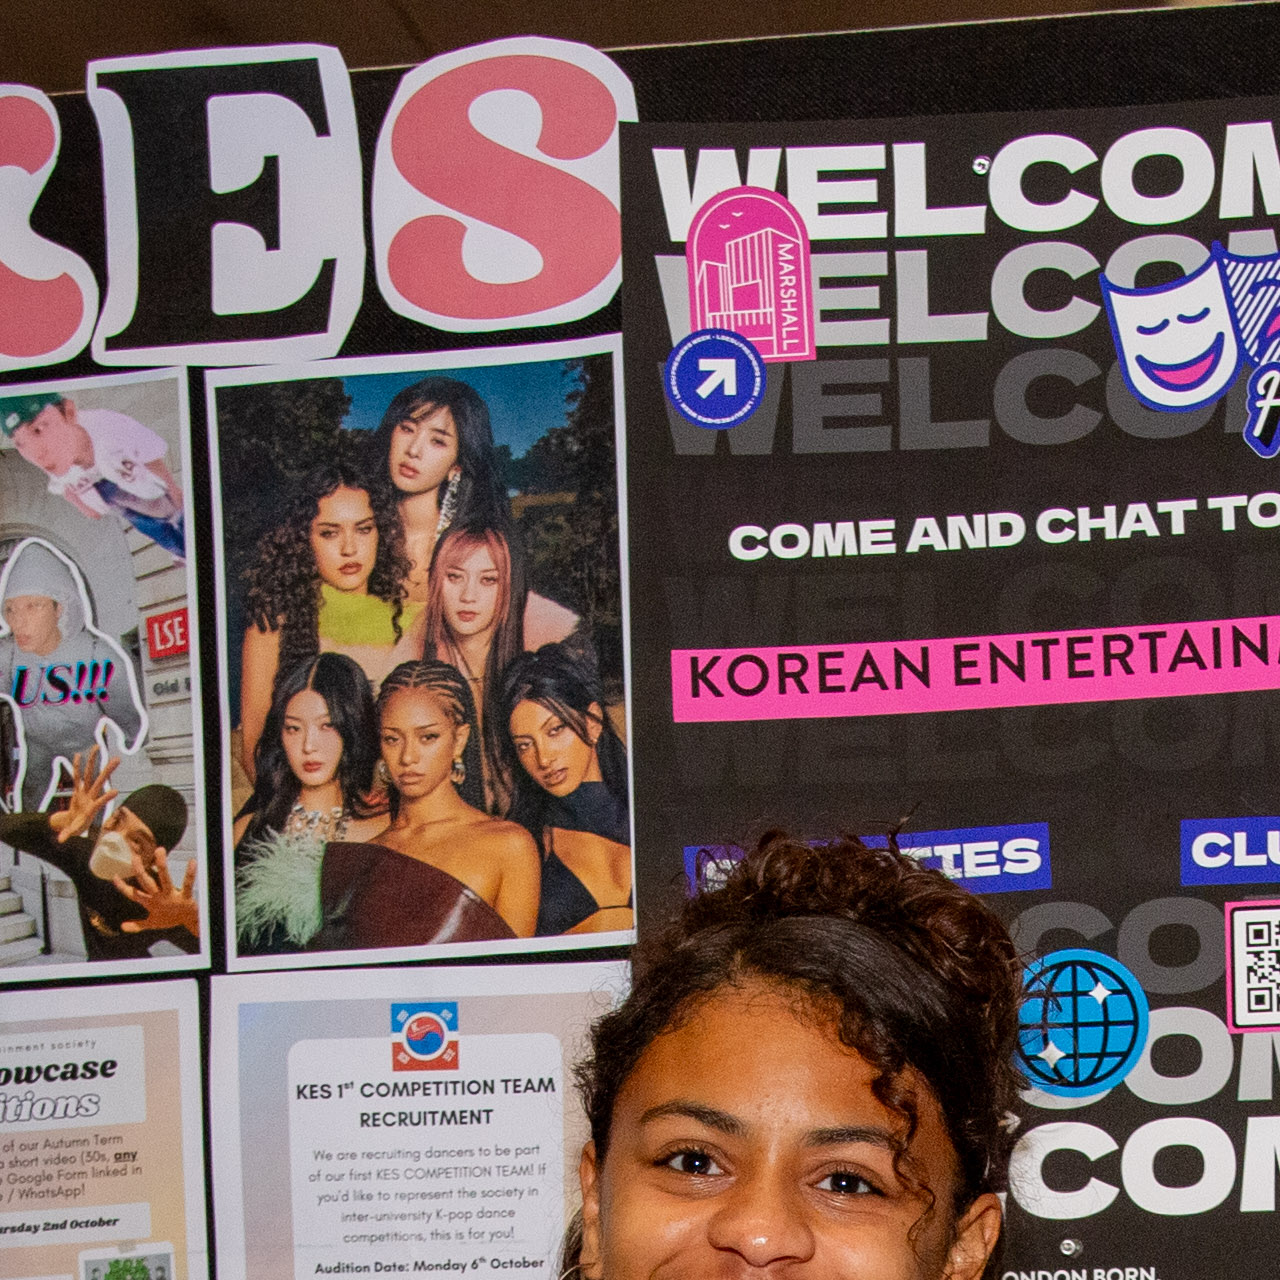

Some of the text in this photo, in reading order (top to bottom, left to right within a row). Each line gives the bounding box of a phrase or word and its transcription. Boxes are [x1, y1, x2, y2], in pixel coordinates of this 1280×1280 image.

[777, 244, 796, 350] MARSHALL
[728, 519, 896, 562] COME
[906, 512, 1025, 552] AND
[1036, 499, 1197, 543] CHAT
[153, 617, 187, 651] LSE
[690, 645, 930, 698] KOREAN
[12, 659, 114, 708] US!!!
[51, 1040, 96, 1050] society
[296, 1077, 556, 1100] KES 1st COMPETITION TEAM
[360, 1109, 493, 1128] RECRUITMENT
[3, 1134, 123, 1152] of our Autumn Term
[8, 1156, 39, 1169] short
[43, 1152, 77, 1165] video
[114, 1151, 138, 1163] any
[313, 1145, 540, 1162] We are recruiting dancers to be part
[7, 1165, 142, 1186] Google Form linked in
[309, 1170, 321, 1182] of
[325, 1173, 345, 1182] our
[349, 1169, 372, 1181] first
[376, 1168, 400, 1180] KES
[404, 1165, 491, 1180] COMPETITION
[495, 1164, 534, 1177] TEAM!
[18, 1184, 85, 1199] WhatsApp!
[317, 1186, 539, 1206] you'd like to represent the society in
[43, 1217, 120, 1231] 2nd October
[341, 1206, 516, 1225] inter-university K-pop dance
[343, 1231, 426, 1245] competitions,
[430, 1229, 451, 1241] this
[468, 1228, 485, 1240] for
[489, 1226, 515, 1243] you!
[314, 1257, 544, 1275] Audition Date: Monday 6th October
